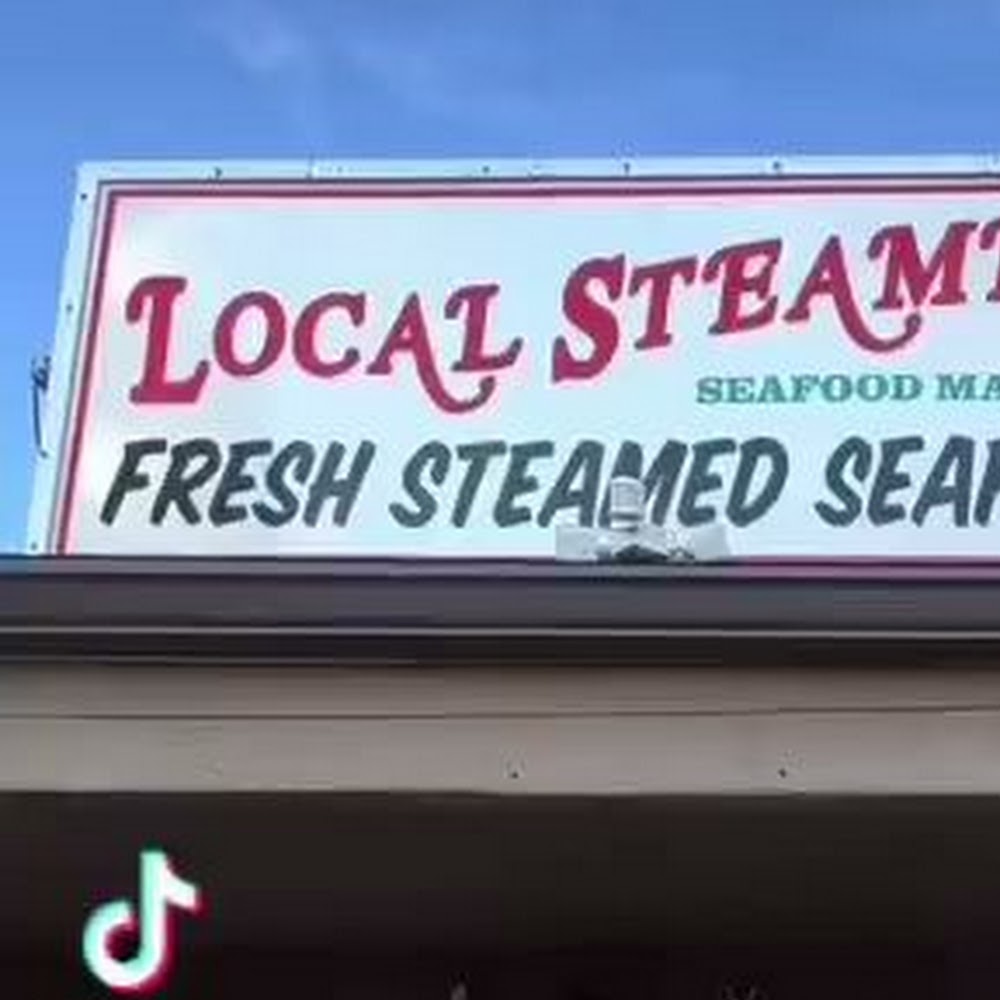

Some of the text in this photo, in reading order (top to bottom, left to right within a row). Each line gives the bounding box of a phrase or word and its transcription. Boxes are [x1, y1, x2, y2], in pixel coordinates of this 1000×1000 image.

[696, 373, 922, 404] SEAFOOD
[100, 438, 375, 527] FRESH
[389, 437, 789, 528] STEAMED
